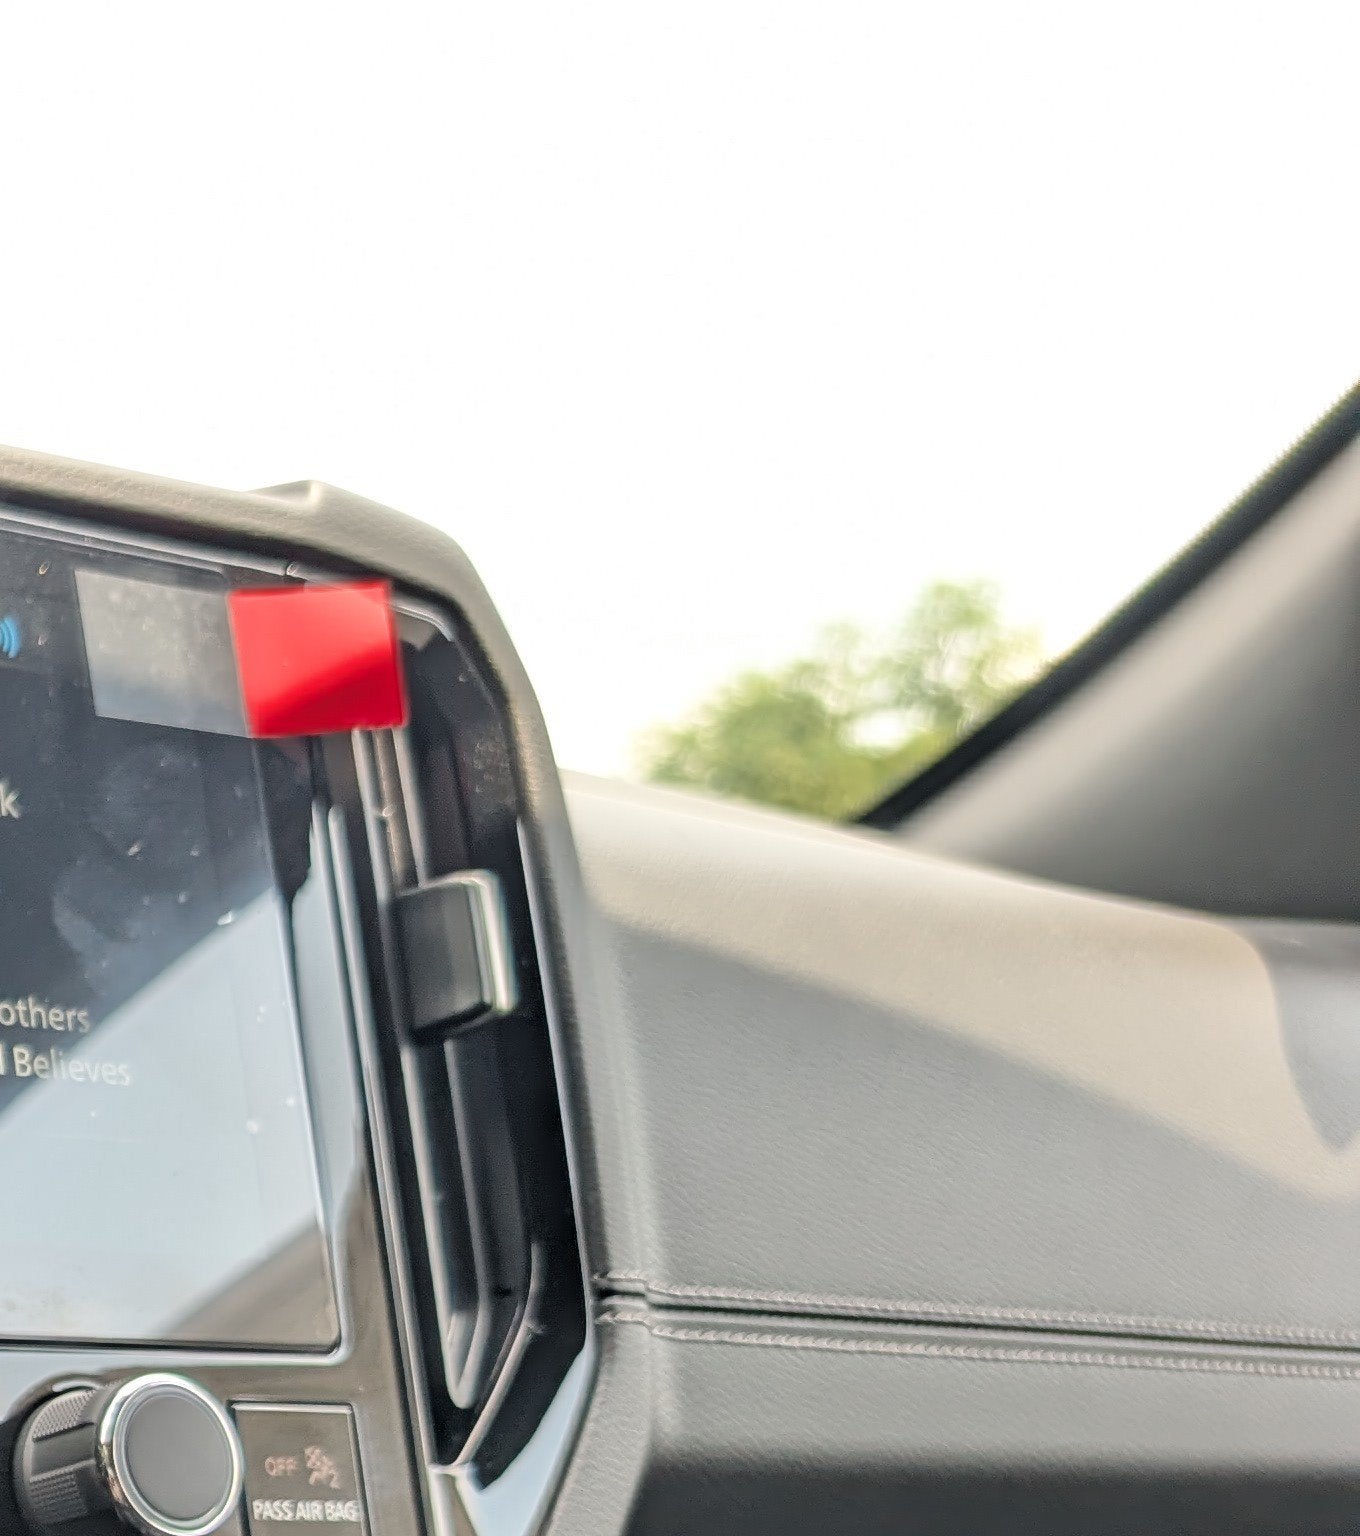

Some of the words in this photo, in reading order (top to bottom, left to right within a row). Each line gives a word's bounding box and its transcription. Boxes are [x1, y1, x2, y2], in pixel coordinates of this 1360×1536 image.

[11, 1042, 132, 1086] Believes
[264, 1455, 297, 1477] OFF
[252, 1499, 295, 1521] PASS
[295, 1500, 325, 1521] AIR
[325, 1500, 363, 1522] BAG
